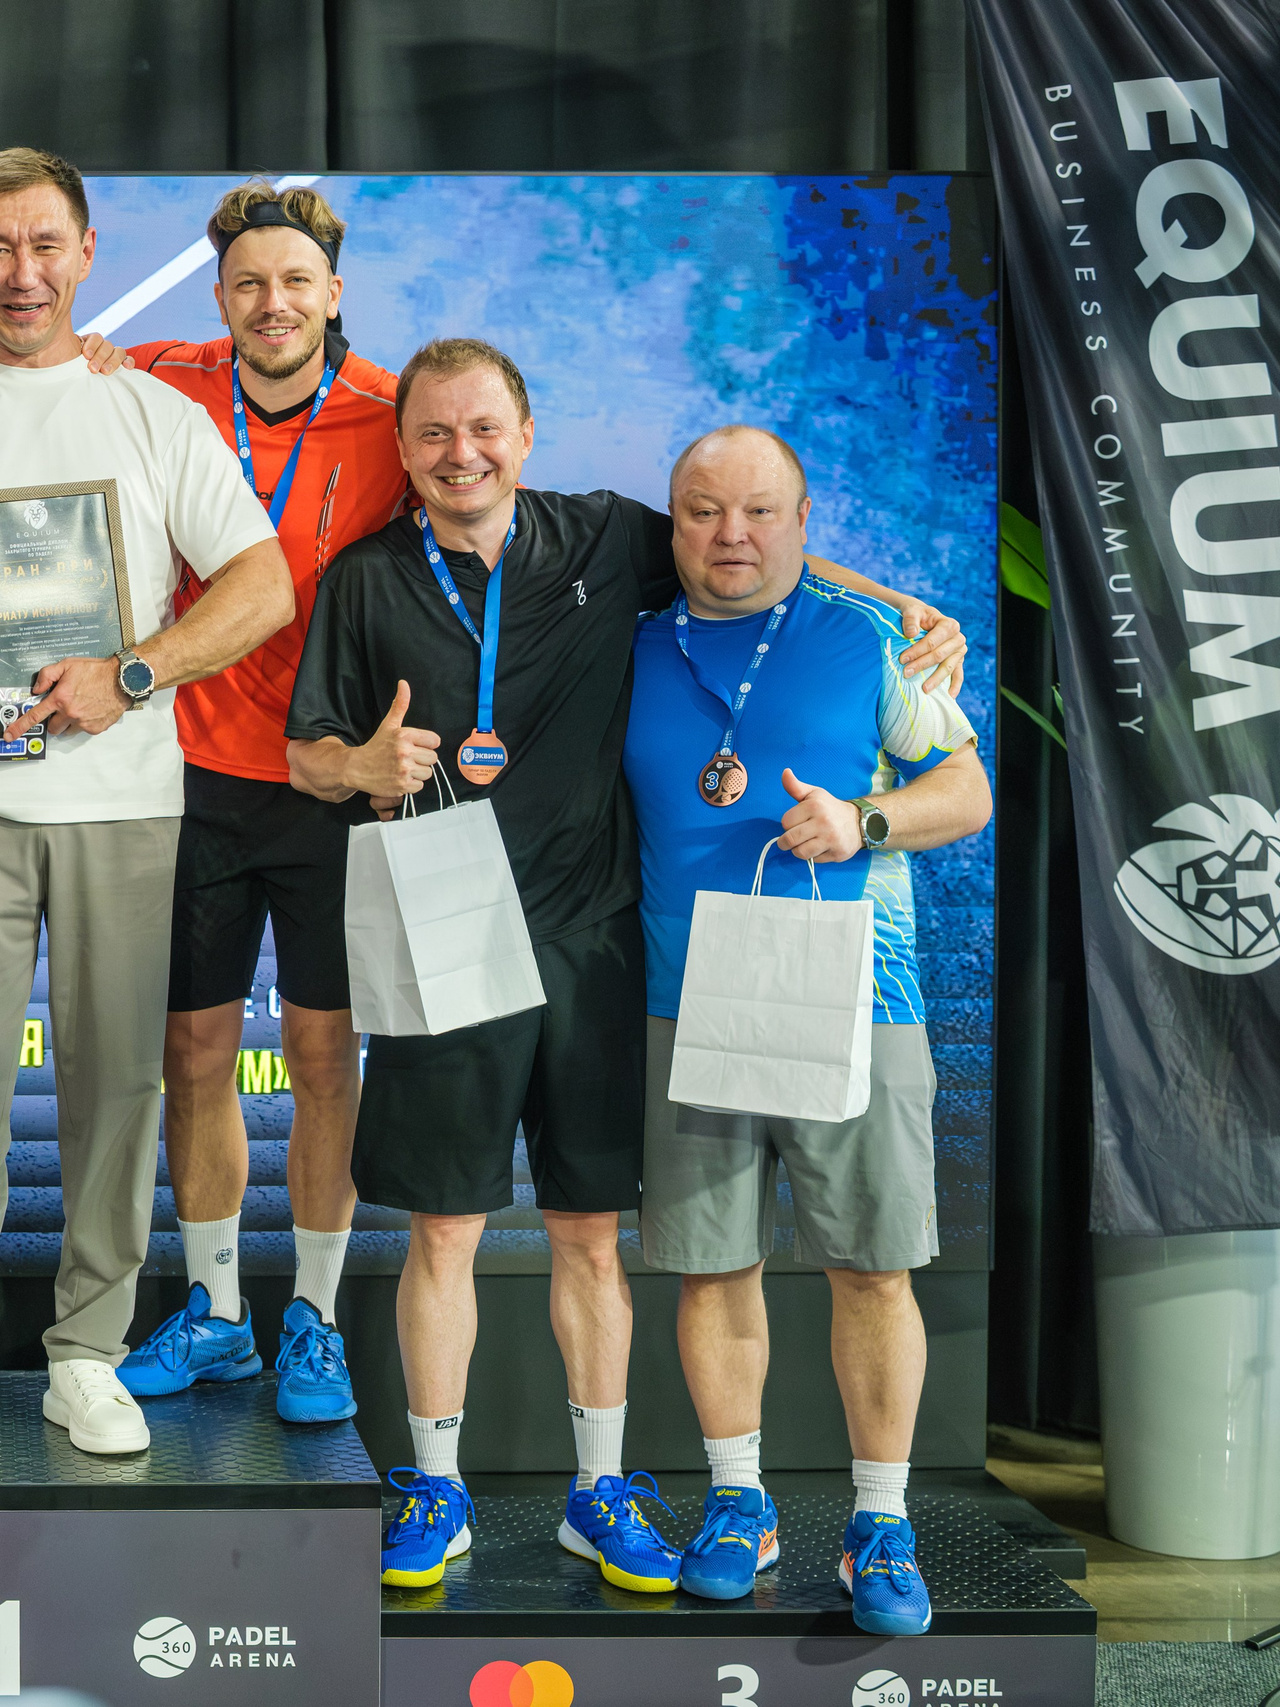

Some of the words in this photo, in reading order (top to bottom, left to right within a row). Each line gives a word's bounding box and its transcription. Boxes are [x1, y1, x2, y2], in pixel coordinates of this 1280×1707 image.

[1045, 84, 1108, 351] BUSINESS
[1091, 394, 1144, 734] COMMUNITY
[1113, 76, 1280, 731] EQUIUM
[16, 529, 60, 538] EQUIUM
[705, 771, 719, 790] 3
[211, 1338, 251, 1364] LACOSTE
[209, 1627, 296, 1645] PADEL
[161, 1641, 191, 1654] 360
[210, 1652, 296, 1668] ARENA
[922, 1678, 1002, 1696] PADEL
[878, 1692, 905, 1704] 360
